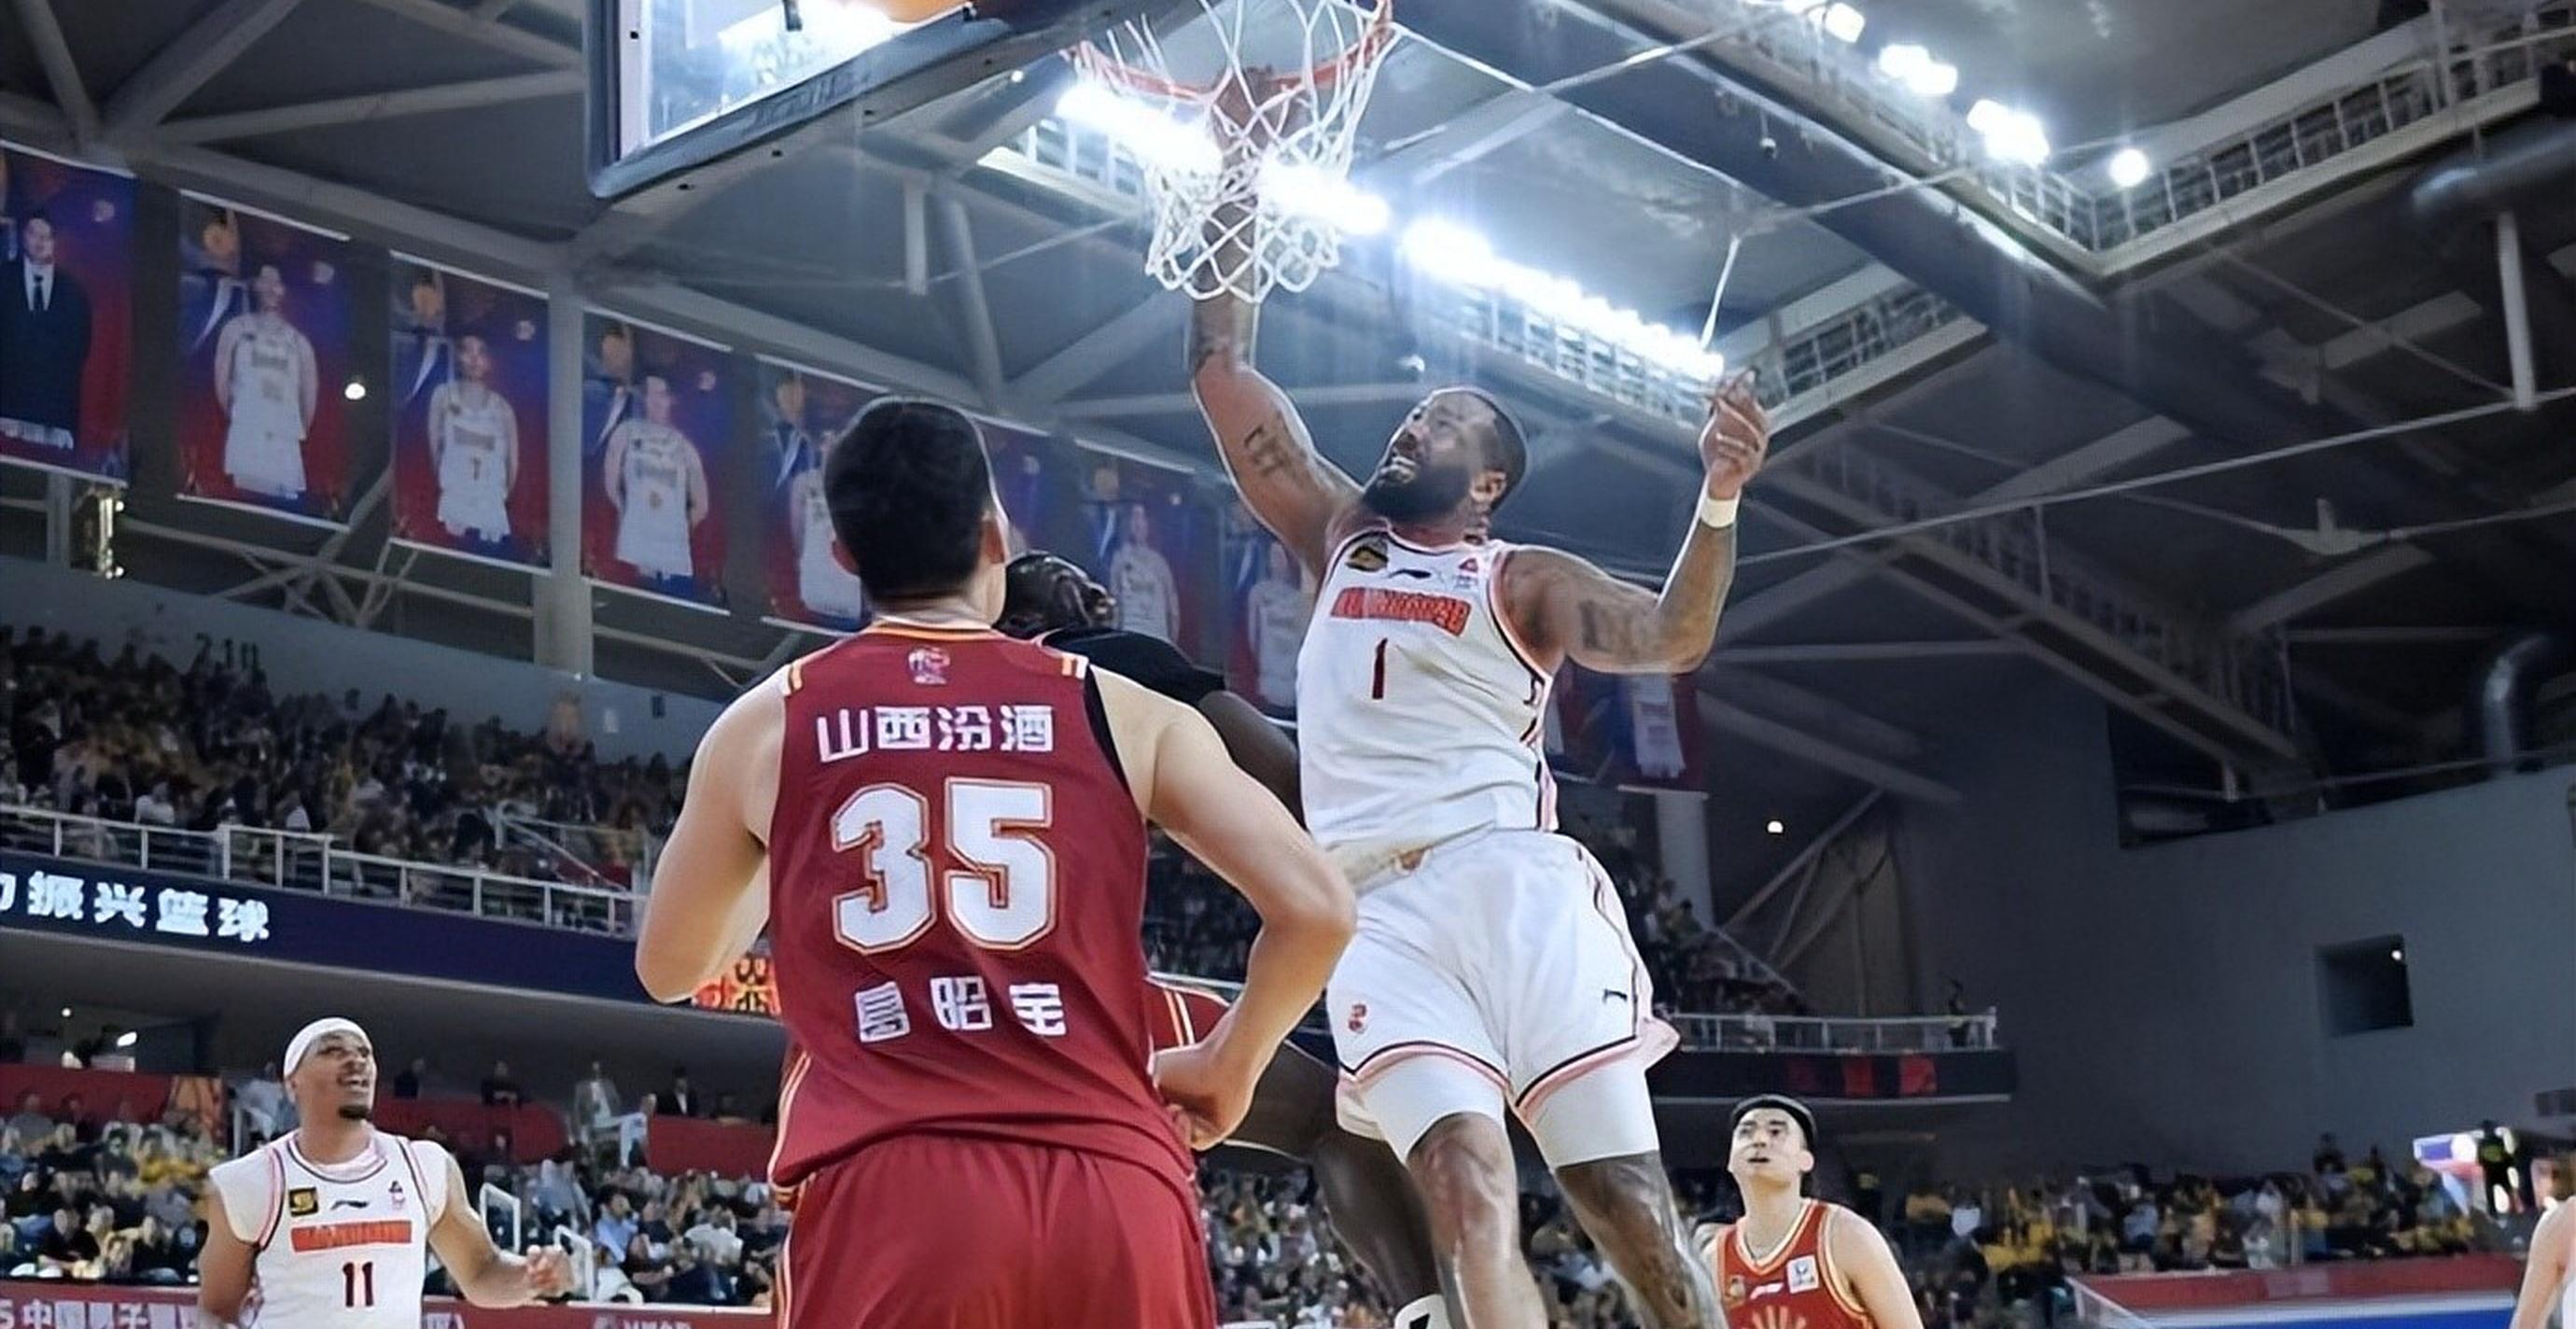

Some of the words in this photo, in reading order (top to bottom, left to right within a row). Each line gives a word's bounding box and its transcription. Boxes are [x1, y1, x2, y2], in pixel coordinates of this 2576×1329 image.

[1372, 637, 1388, 699] 1
[817, 706, 1054, 762] 山西汾酒
[831, 776, 1056, 956] 35
[343, 1262, 374, 1308] 11
